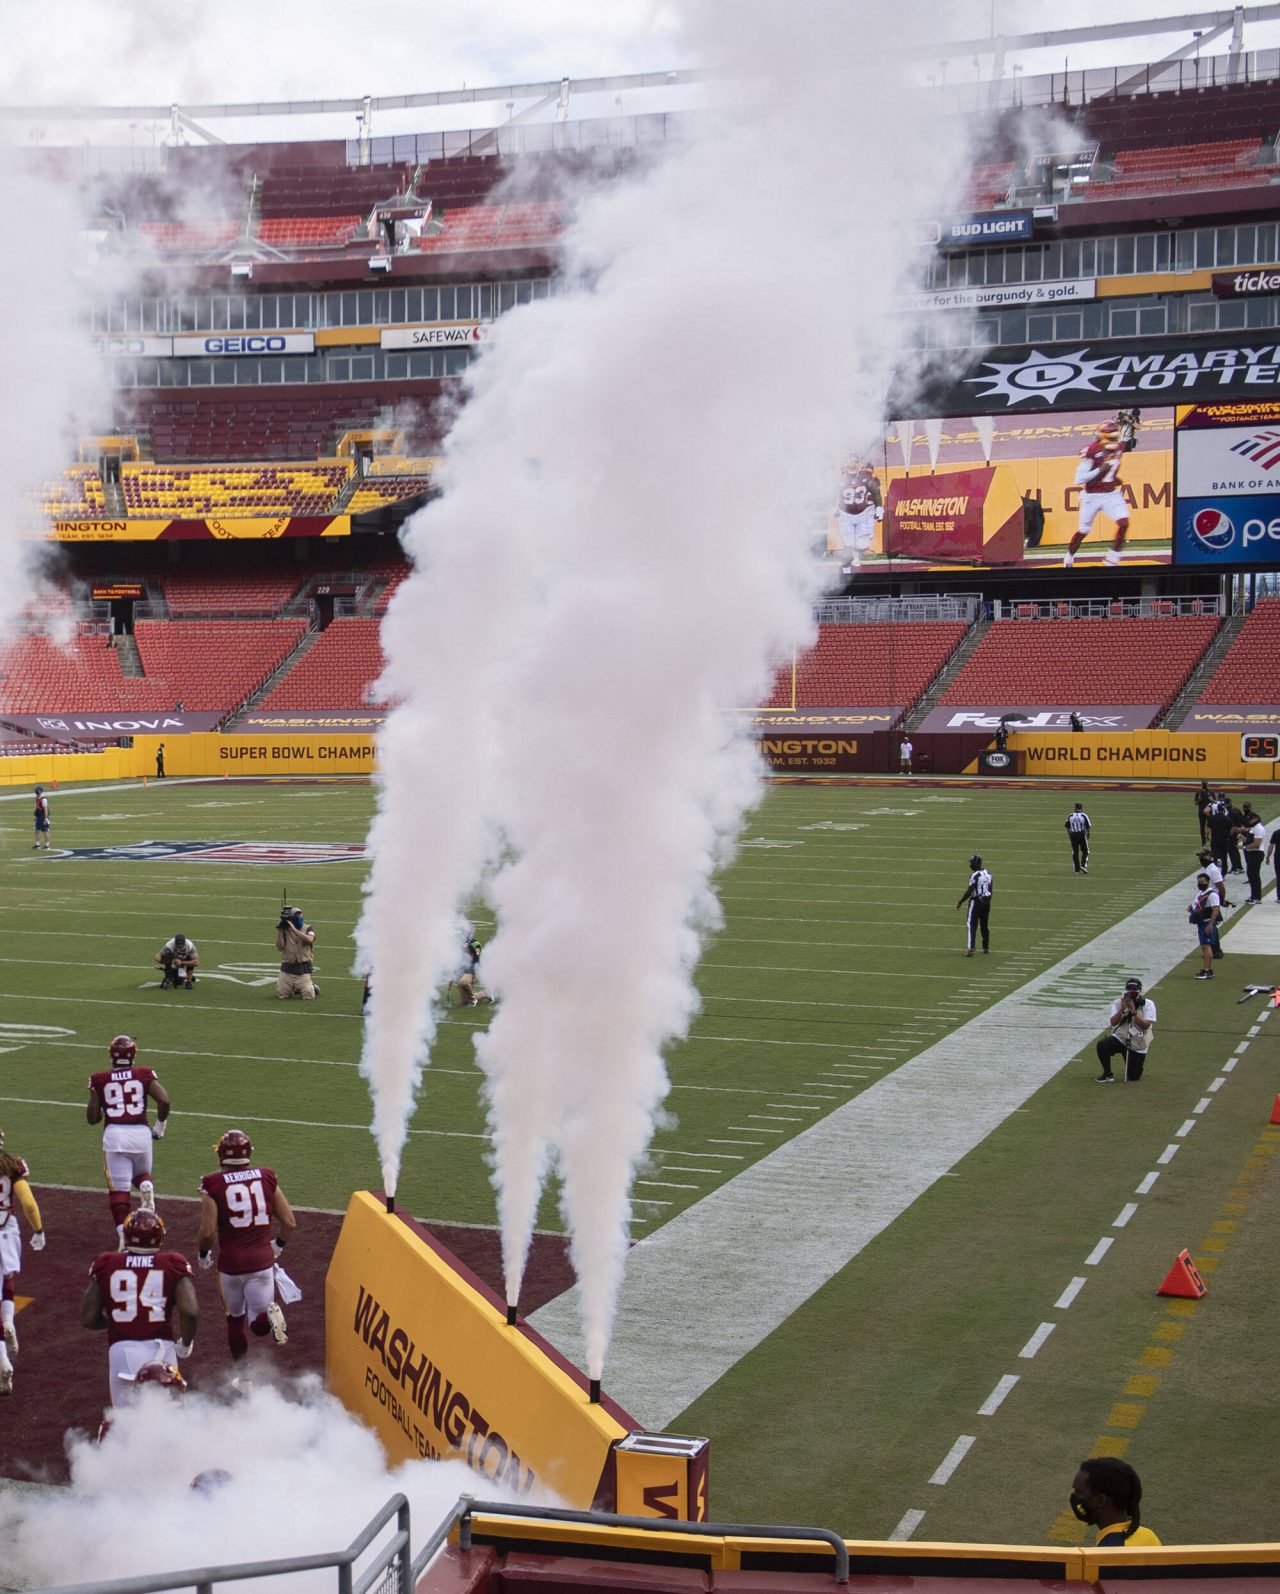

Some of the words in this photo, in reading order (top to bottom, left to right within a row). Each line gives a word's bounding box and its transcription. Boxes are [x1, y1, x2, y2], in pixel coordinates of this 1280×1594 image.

[951, 222, 981, 237] BUD
[983, 220, 1025, 234] LIGHT
[976, 290, 1033, 307] burgundy
[1048, 285, 1079, 300] gold.
[204, 336, 286, 353] GEICO
[412, 328, 470, 344] SAFEWAY
[1116, 345, 1280, 373] MARY
[1106, 364, 1280, 392] LOTTE
[1212, 481, 1245, 490] BANK
[1248, 480, 1263, 489] OF
[895, 496, 968, 517] WASHINGTON
[49, 522, 127, 531] HINGTON
[74, 718, 184, 731] INOVA
[220, 746, 267, 759] SUPER
[272, 746, 314, 759] BOWL
[317, 746, 377, 759] CHAMPI
[1027, 746, 1091, 761] WORLD
[1096, 746, 1207, 762] CHAMPIONS
[1248, 738, 1275, 757] 25
[766, 757, 786, 766] AM,
[788, 757, 809, 765] EST.
[812, 757, 837, 765] 1932
[991, 755, 1004, 763] FOX
[111, 1070, 132, 1081] ALLEN
[103, 1079, 145, 1118] 93
[223, 1168, 262, 1184] KERRIGAN
[224, 1180, 270, 1229] 91
[125, 1254, 154, 1268] PAYNE
[110, 1268, 167, 1323] 94
[354, 1285, 536, 1497] WASHINGTON
[365, 1366, 414, 1442] FOOTBALL
